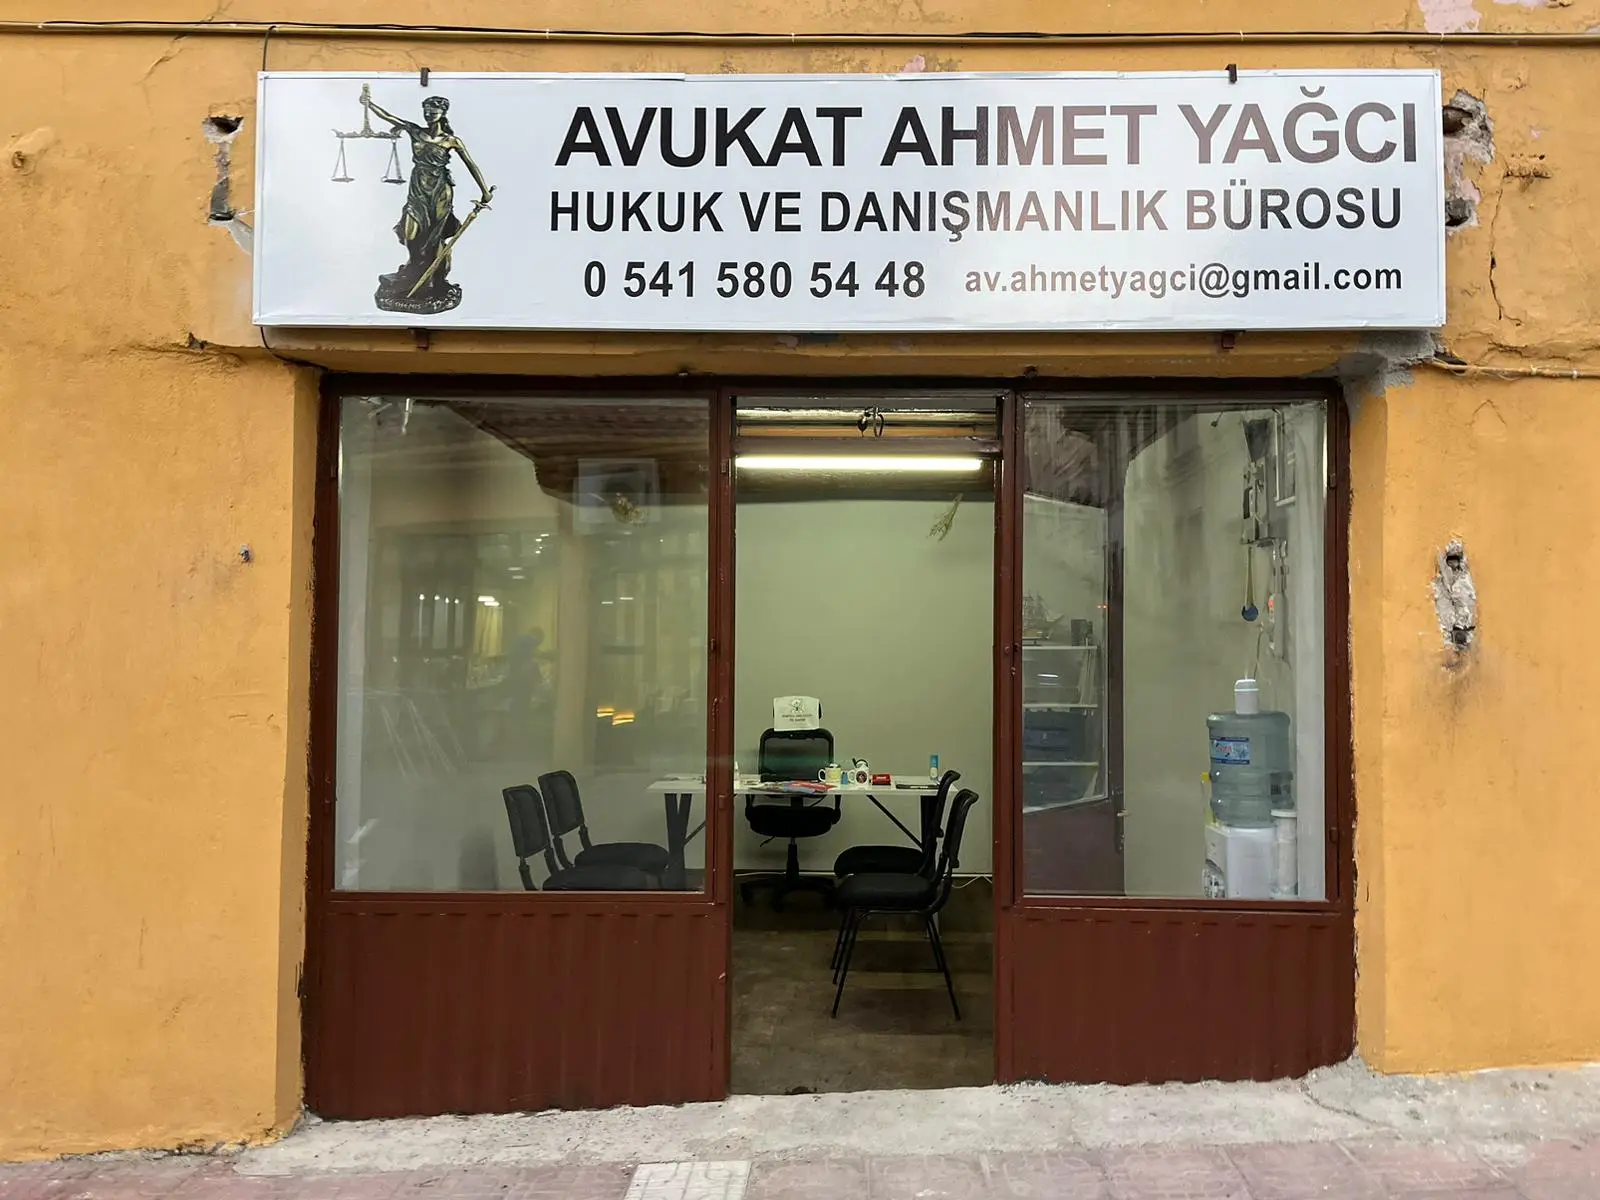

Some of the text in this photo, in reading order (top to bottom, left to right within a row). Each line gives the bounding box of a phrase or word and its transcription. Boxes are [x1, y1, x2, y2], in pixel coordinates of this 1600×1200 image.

[554, 84, 1417, 168] AVUKAT AHMET YAĞCI
[550, 178, 1401, 243] HUKUK VE DANIŞMANLIK BÜROSU
[583, 260, 926, 299] 0 541 580 54 48
[965, 261, 1402, 299] av.ahmetyagci@gmail.com
